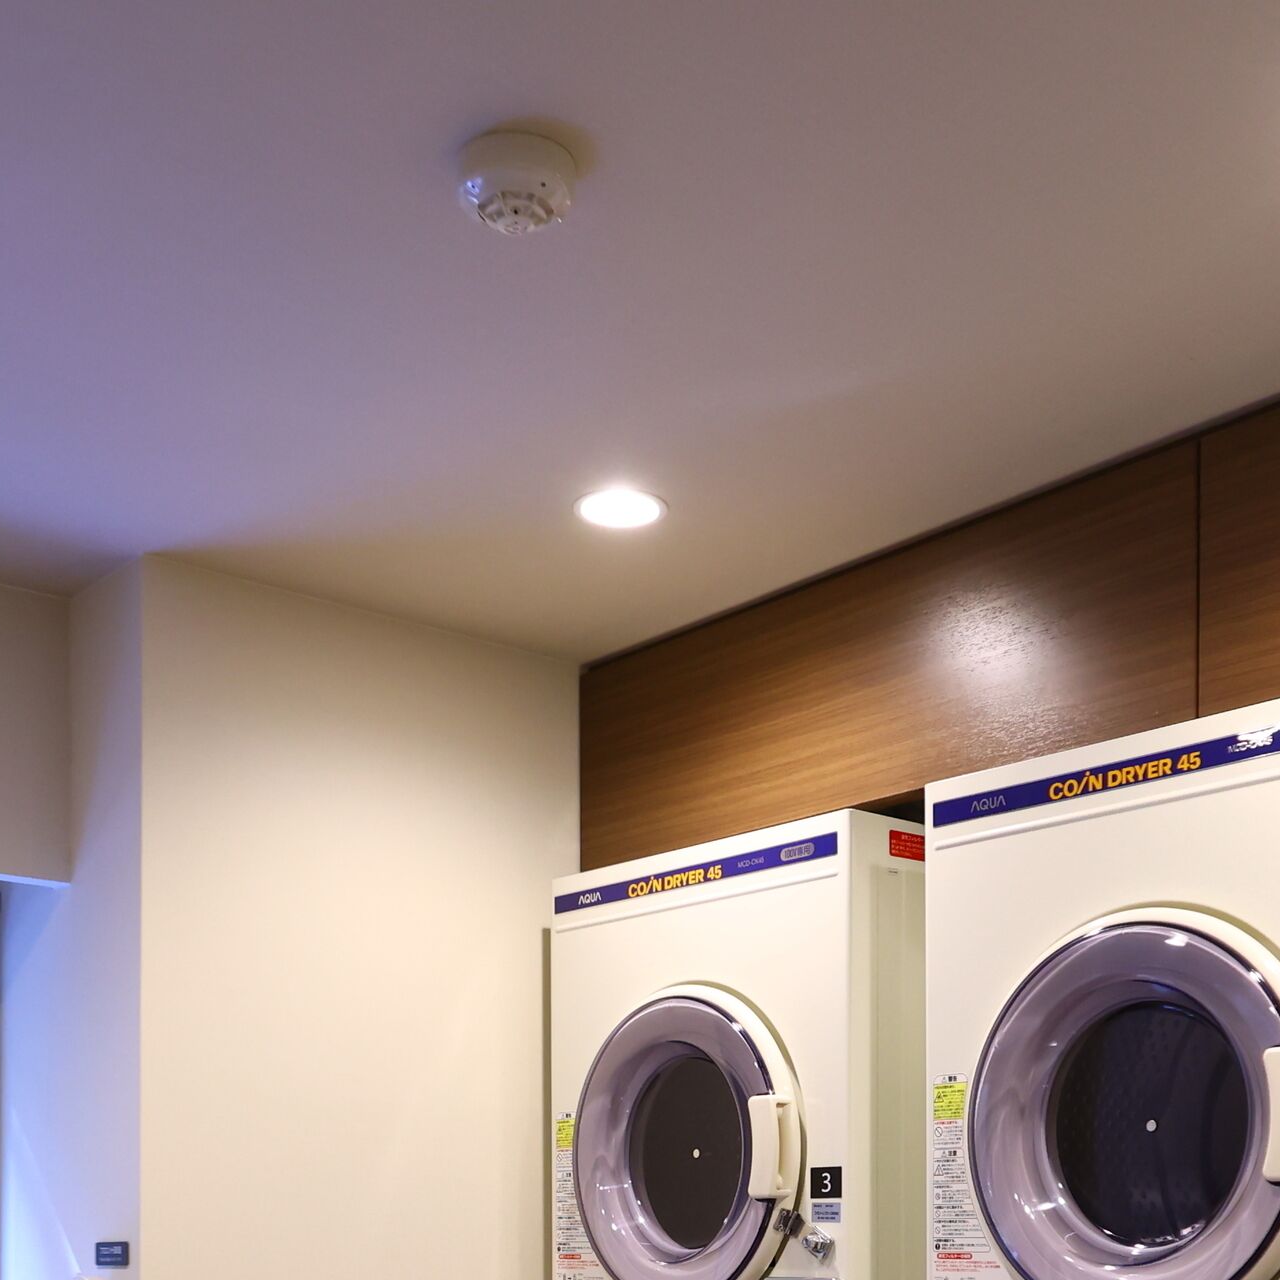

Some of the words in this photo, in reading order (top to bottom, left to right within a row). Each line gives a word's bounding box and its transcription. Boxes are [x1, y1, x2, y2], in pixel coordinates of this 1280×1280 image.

[1048, 771, 1103, 800] COIN
[1107, 757, 1172, 788] DRYER
[1176, 751, 1202, 771] 45
[970, 795, 1006, 814] AQUA
[628, 876, 662, 898] COIN
[664, 868, 704, 890] DRYER
[706, 864, 722, 880] 45
[578, 891, 602, 906] AQUA
[821, 1172, 832, 1193] 3
